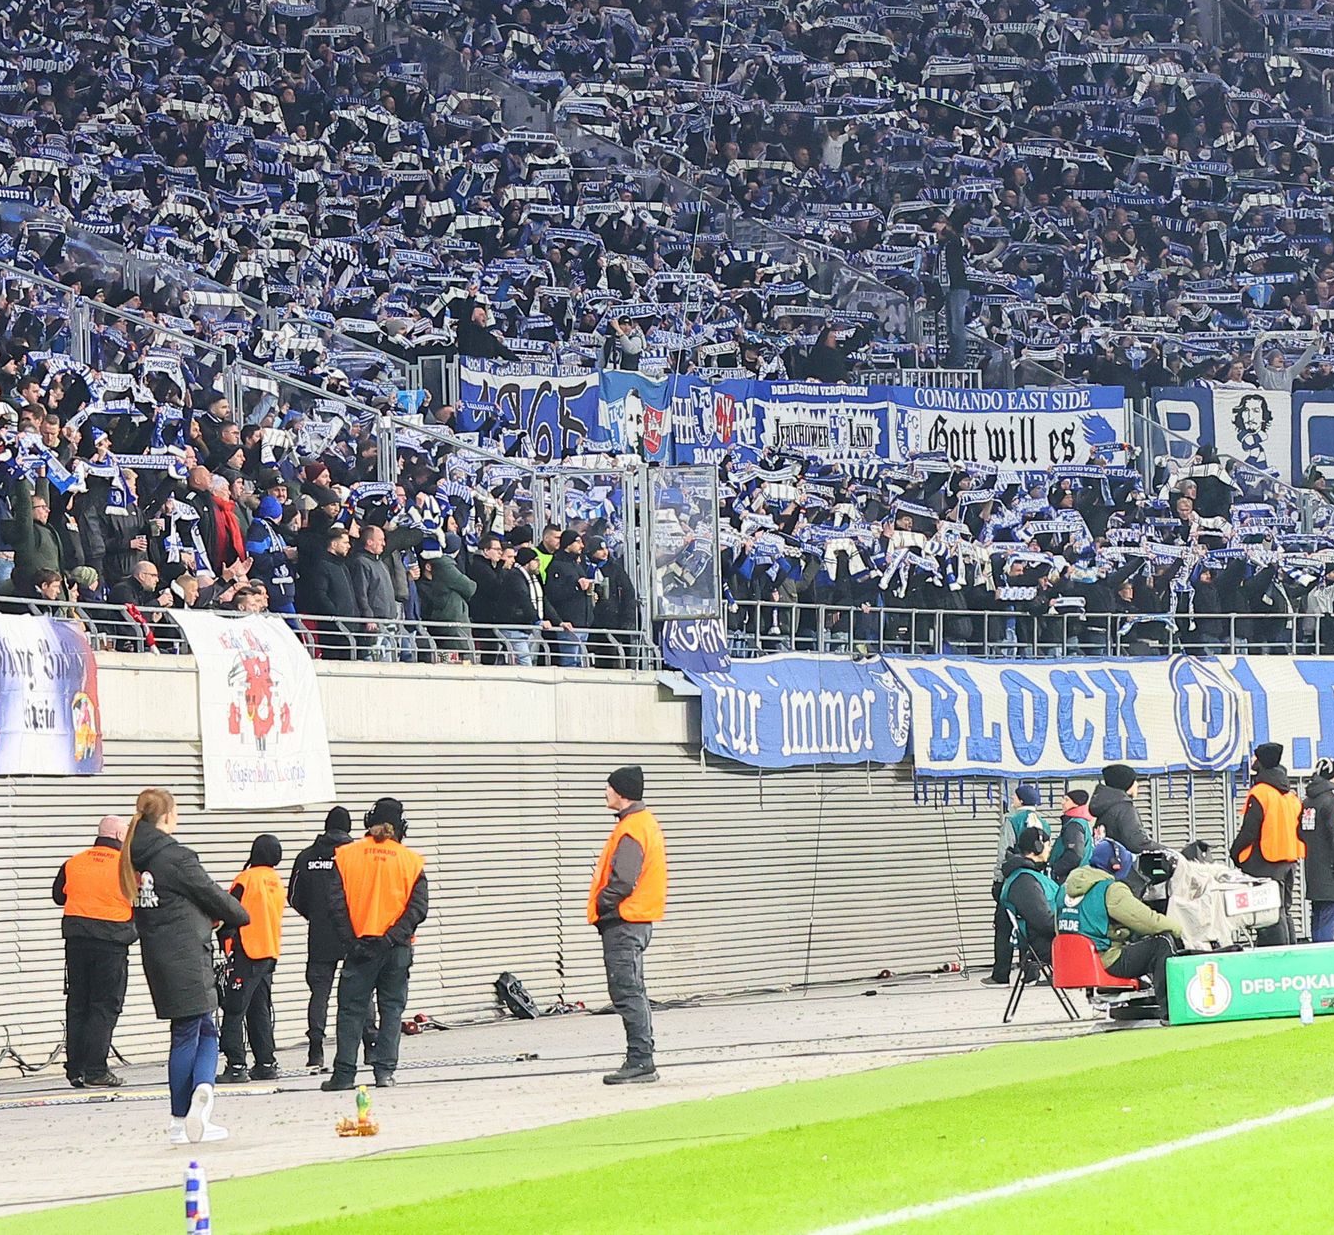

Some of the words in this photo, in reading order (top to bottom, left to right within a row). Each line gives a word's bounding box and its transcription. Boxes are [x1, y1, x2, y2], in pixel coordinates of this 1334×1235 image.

[1124, 195, 1155, 206] immer
[1236, 273, 1296, 285] ZERBST
[467, 356, 483, 373] NOCH
[533, 362, 554, 376] NICHT
[556, 363, 592, 377] VERLOREN
[771, 385, 791, 396] DER
[793, 385, 819, 397] REGION
[820, 385, 868, 398] VERBUNDEN
[914, 387, 1003, 411] COMMANDO
[1007, 390, 1049, 410] EAST
[1052, 389, 1092, 410] SIDE
[772, 418, 830, 449] JERICHOWER
[848, 417, 874, 448] LAND
[927, 414, 979, 463] Gott
[984, 415, 1039, 465] will
[1048, 421, 1077, 464] es
[117, 456, 176, 465] MAGDEBURG
[767, 674, 877, 757] immer
[907, 665, 1148, 767] BLOCK
[87, 849, 117, 860] STEWARD
[363, 846, 398, 858] STEWARD
